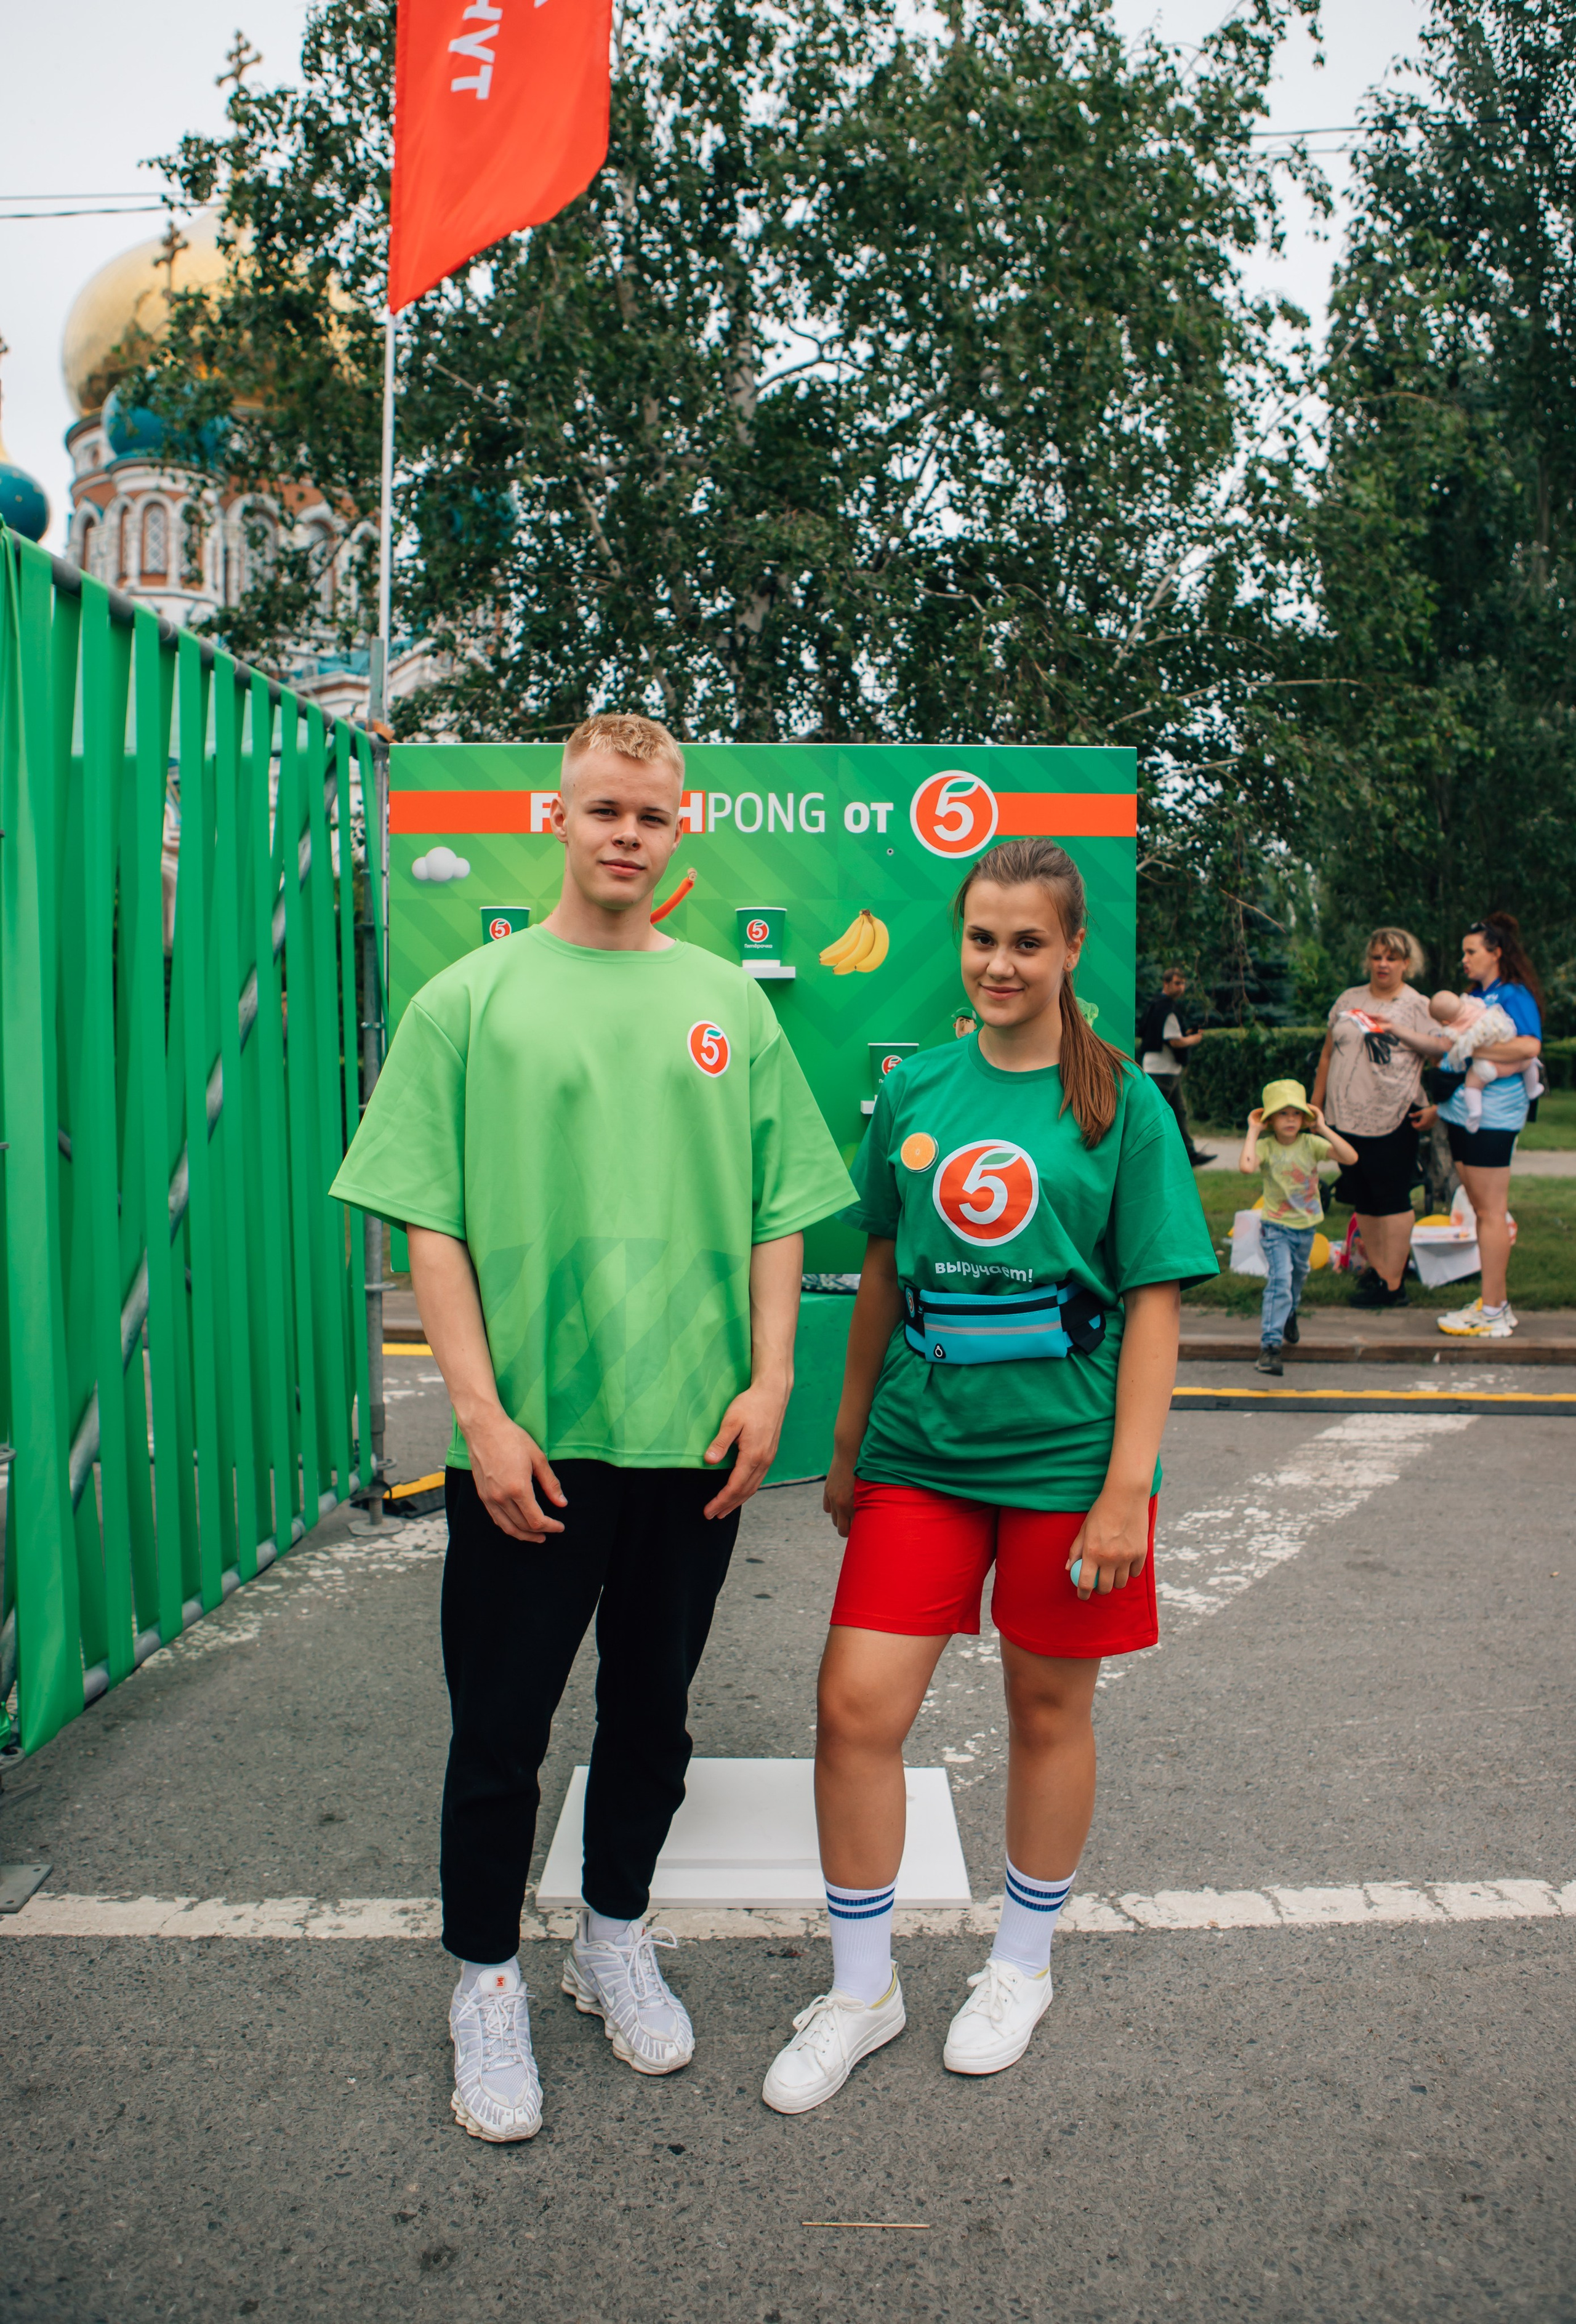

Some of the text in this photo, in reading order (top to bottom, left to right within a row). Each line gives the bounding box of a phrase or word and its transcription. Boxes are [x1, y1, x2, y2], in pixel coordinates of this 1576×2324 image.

[844, 802, 894, 833] от
[959, 1147, 1020, 1224] 5
[935, 1261, 1033, 1283] выручает!
